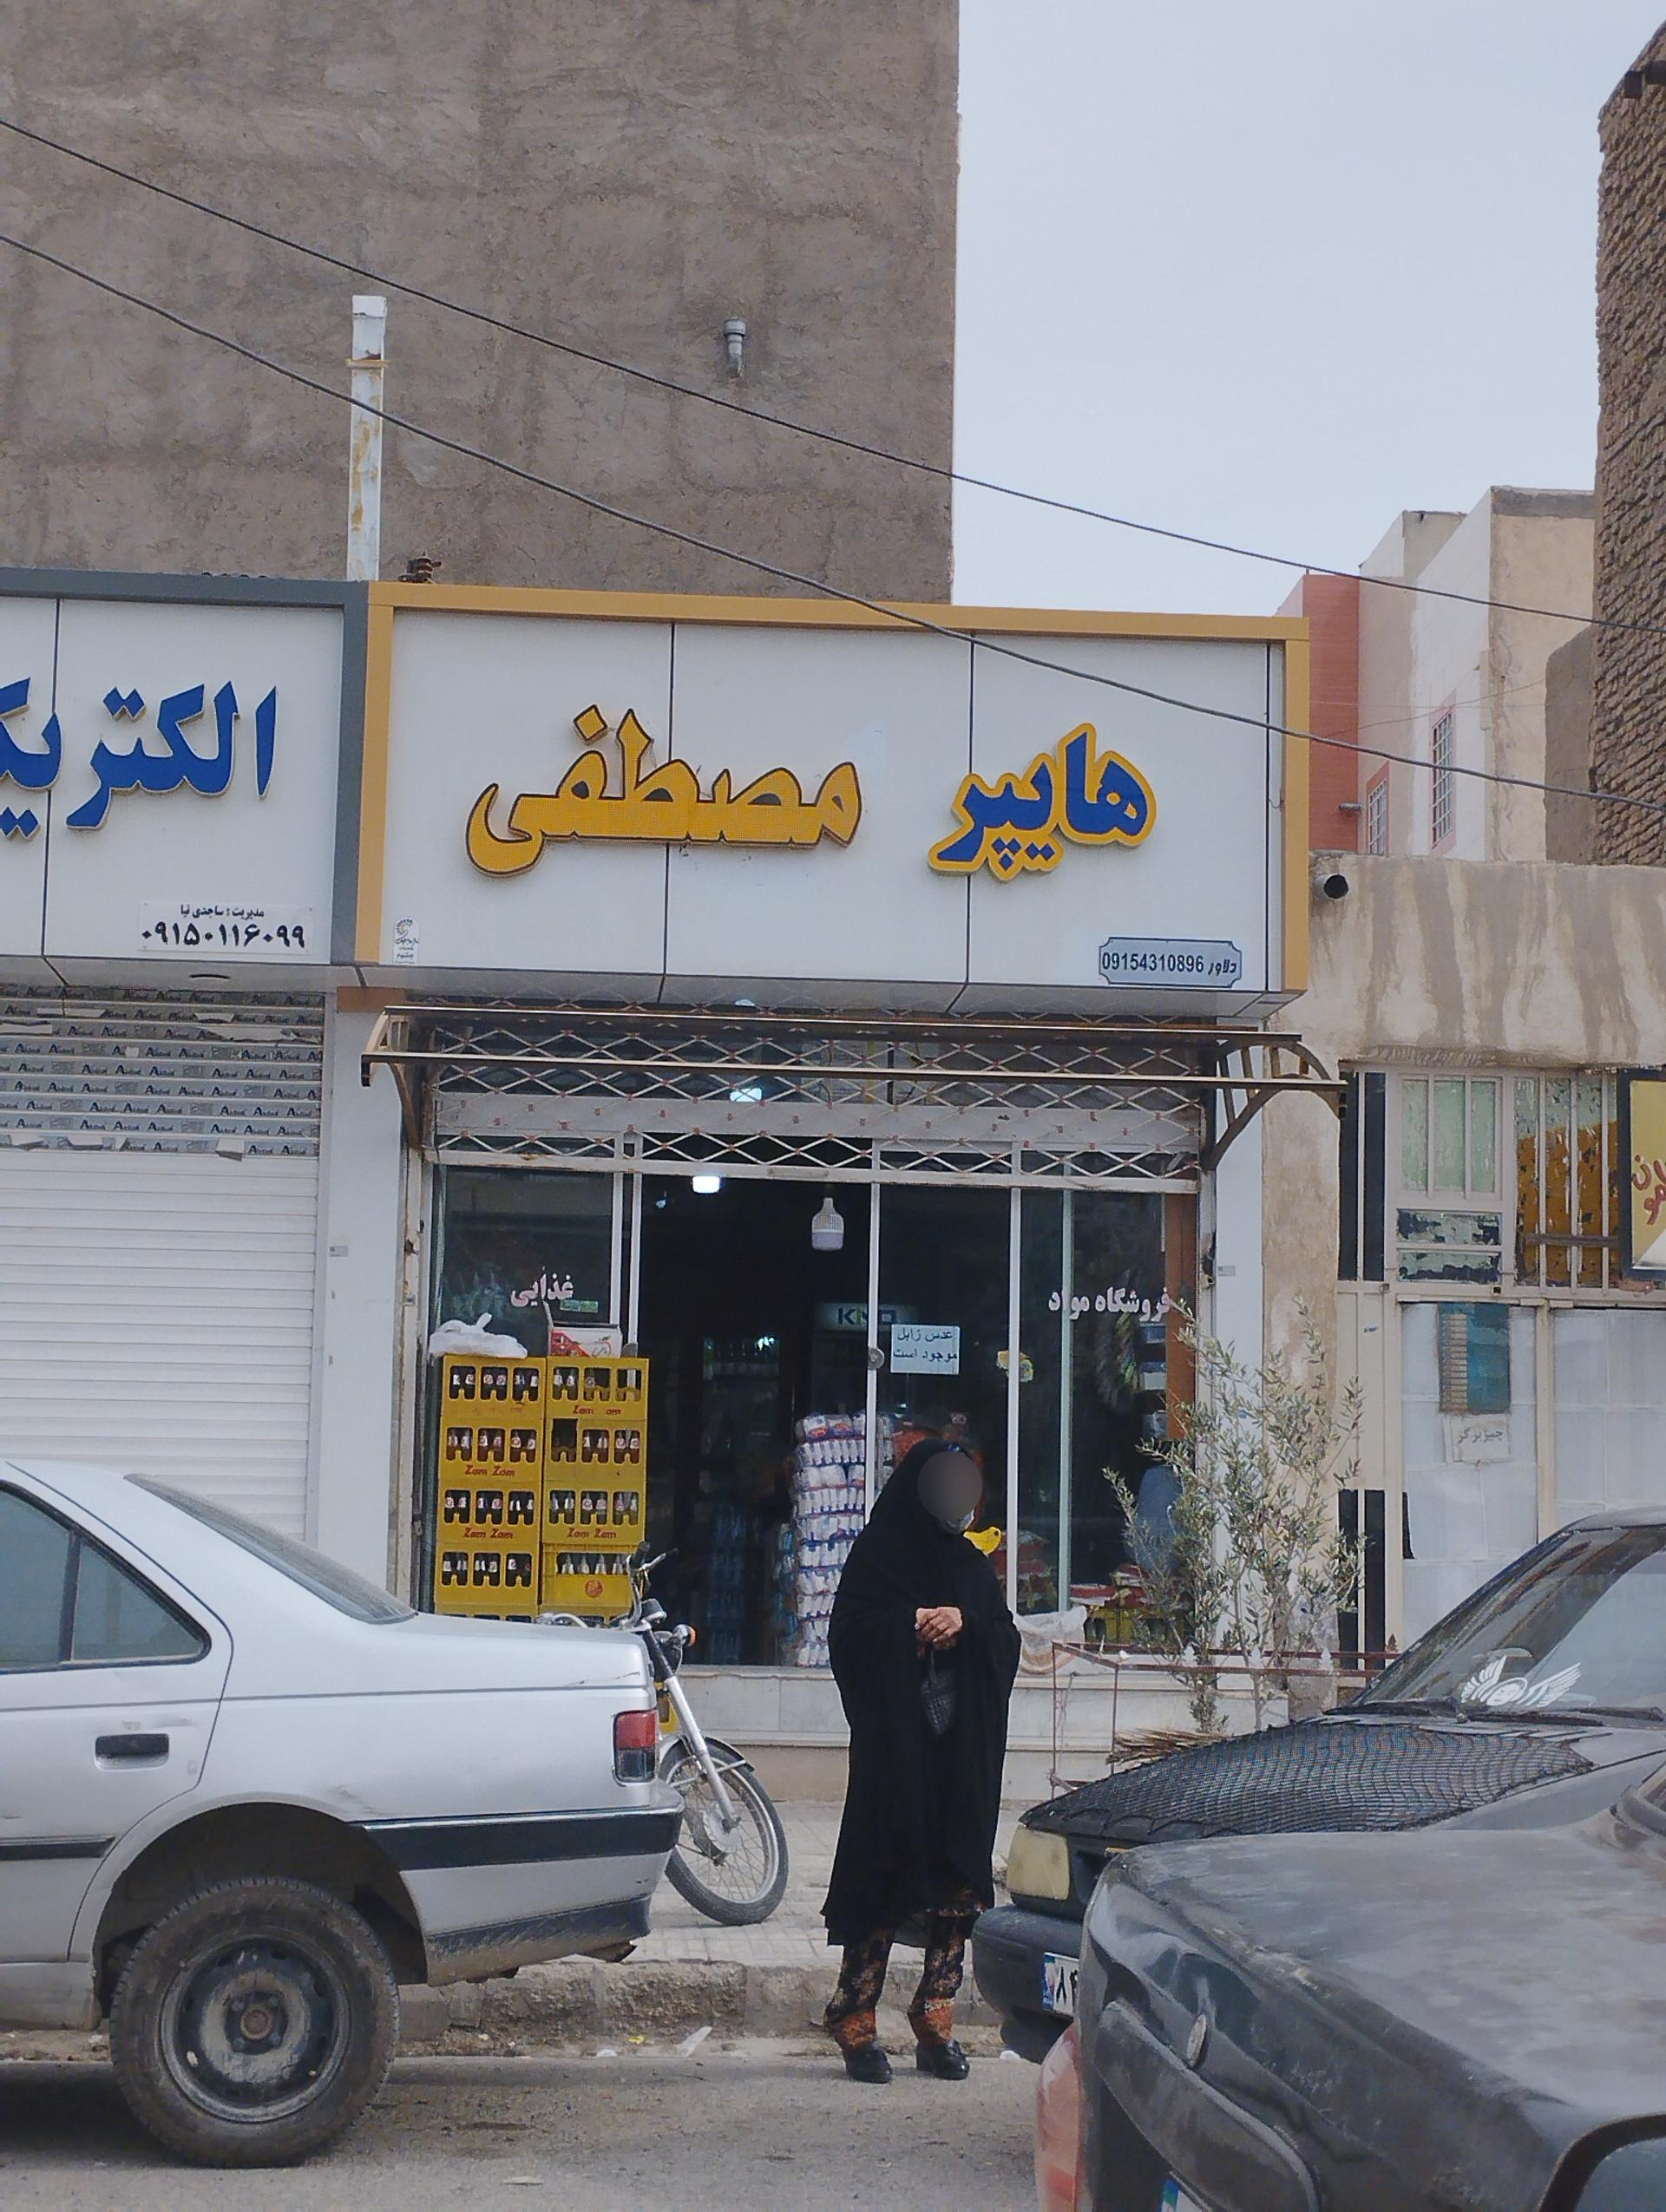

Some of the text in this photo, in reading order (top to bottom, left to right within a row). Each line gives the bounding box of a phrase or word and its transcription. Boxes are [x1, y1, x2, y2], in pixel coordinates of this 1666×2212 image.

[466, 704, 1157, 881] هایپر مصطفی
[141, 921, 305, 948] ۰۹۱۵۰۱۱۶۰۹۹
[1102, 952, 1204, 973] 09154310896
[510, 1273, 574, 1307] غذایی
[1047, 1286, 1171, 1322] فروشگاه مواد
[464, 1464, 515, 1477] Zam Zam
[462, 1527, 514, 1540] Zam Zam
[567, 1527, 617, 1540] Zam Zam
